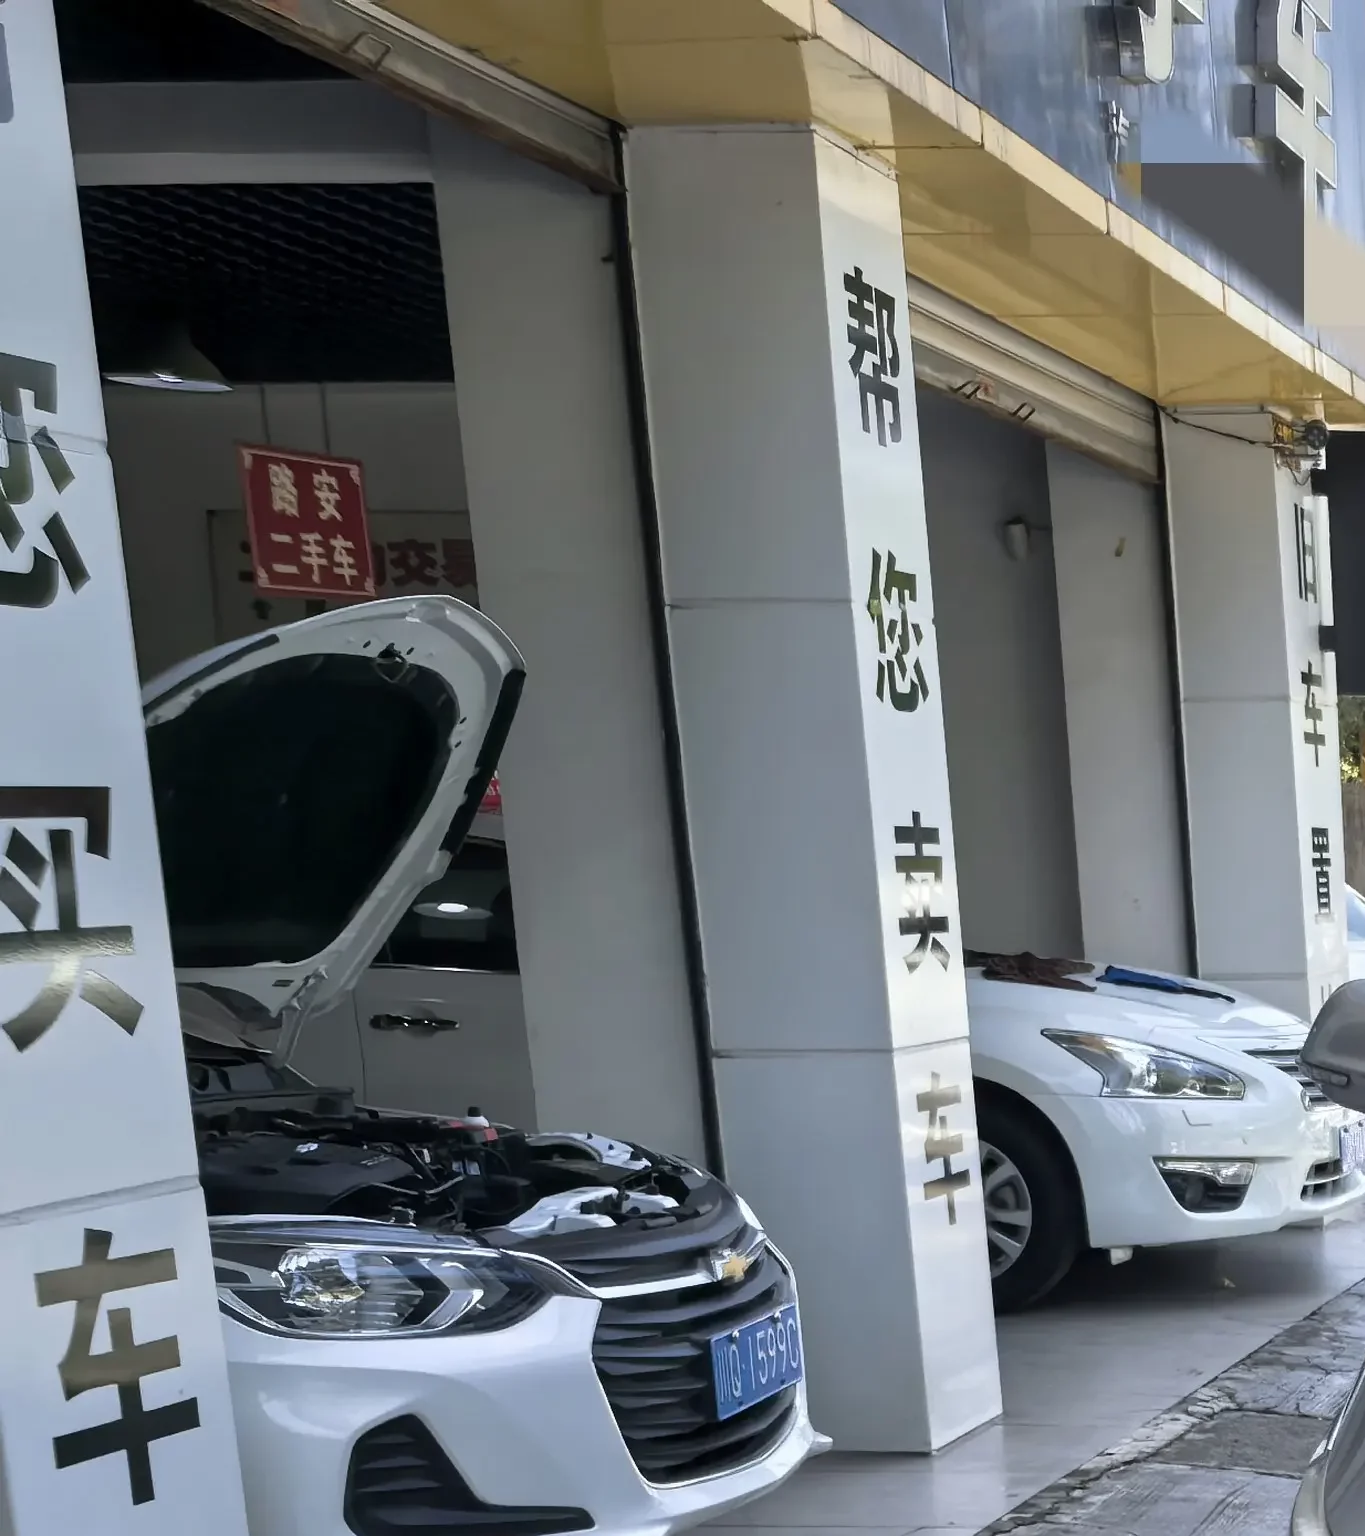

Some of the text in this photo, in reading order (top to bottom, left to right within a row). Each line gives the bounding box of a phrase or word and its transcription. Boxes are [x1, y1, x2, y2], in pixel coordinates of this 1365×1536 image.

[0, 22, 201, 1506] 您买车
[270, 532, 358, 586] 二手车
[843, 265, 971, 1226] 帮您卖车
[1293, 502, 1333, 1004] 旧车置
